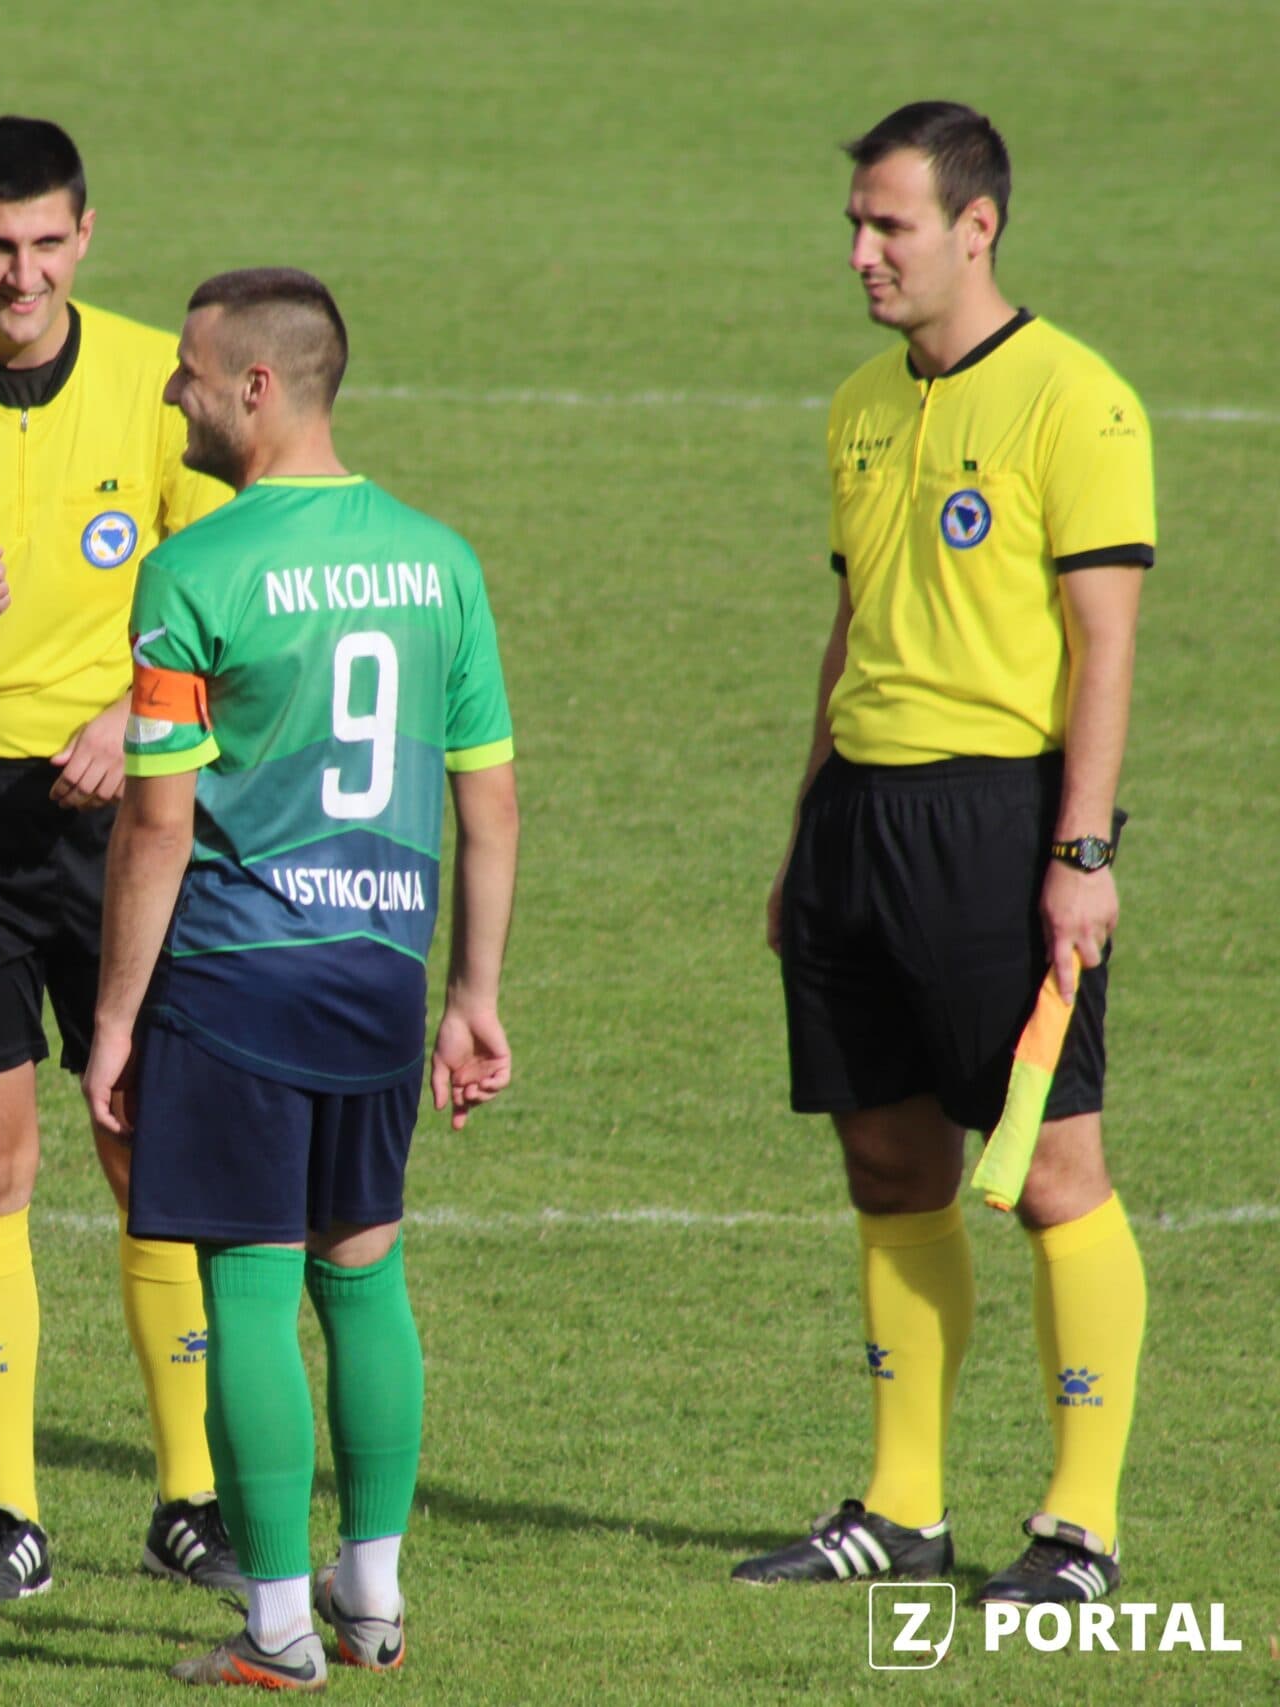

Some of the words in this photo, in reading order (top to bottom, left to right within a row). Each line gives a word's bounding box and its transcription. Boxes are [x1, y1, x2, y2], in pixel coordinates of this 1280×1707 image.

[265, 567, 319, 616] NK
[324, 562, 443, 609] KOLINA
[322, 630, 399, 819] 9
[273, 868, 425, 911] USTIKOLINA
